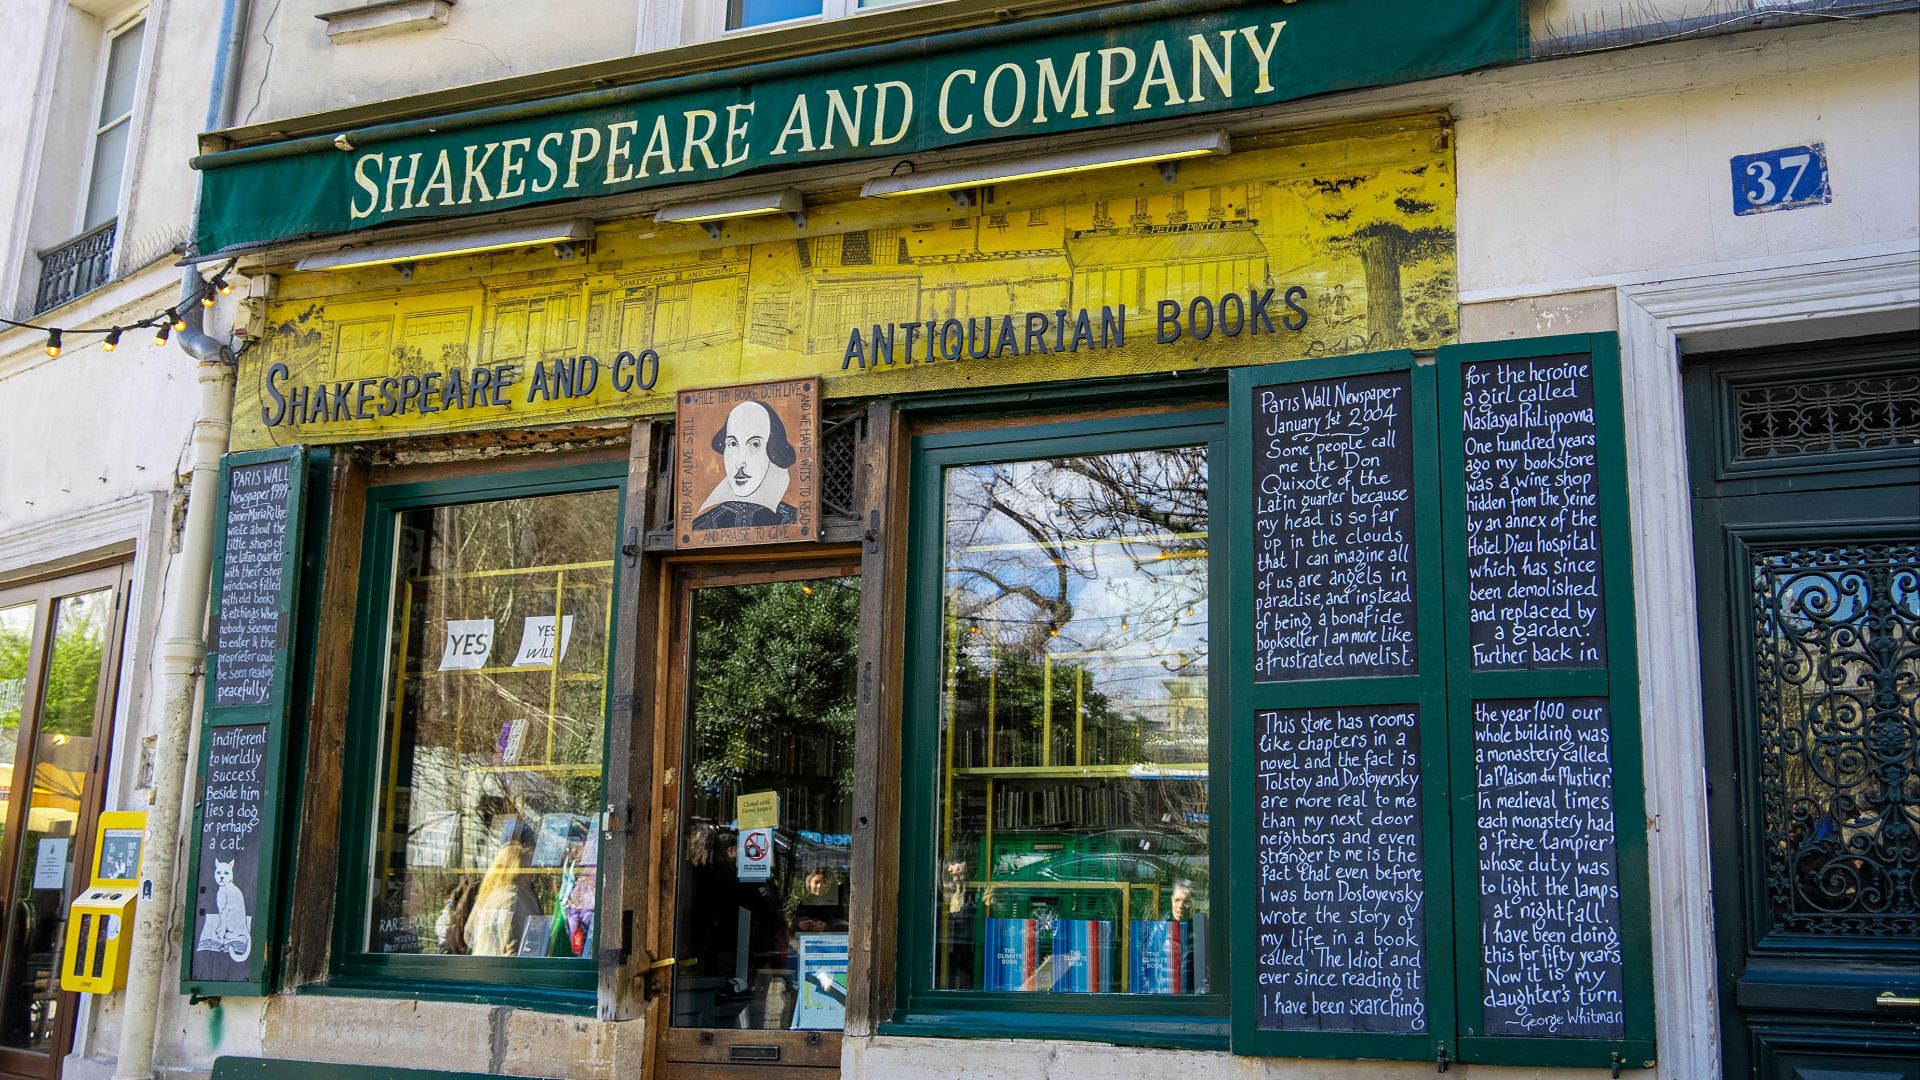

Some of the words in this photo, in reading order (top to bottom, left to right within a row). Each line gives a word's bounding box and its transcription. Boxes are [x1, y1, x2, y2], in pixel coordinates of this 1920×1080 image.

[350, 101, 755, 220] SHAKESPEARE
[770, 80, 913, 155] AND
[938, 21, 1286, 135] COMPANY
[1747, 154, 1809, 205] 37
[618, 276, 668, 288] SHAKESPEARE
[706, 266, 740, 276] COMPANY
[842, 305, 1125, 369] ANTIQUARIAN
[1157, 286, 1308, 344] BOOKS
[1465, 365, 1489, 388] for
[1498, 365, 1525, 383] the
[1530, 363, 1589, 383] heroine
[261, 363, 514, 426] SHAKESPEARE
[527, 355, 598, 402] AND
[612, 349, 659, 393] CO
[692, 392, 713, 405] WHILE
[718, 391, 731, 402] THY
[735, 388, 757, 400] BOOKE
[761, 386, 781, 398] DOTH
[784, 382, 801, 397] LIVE
[1302, 386, 1331, 410] Wall
[1335, 382, 1400, 410] Newspaper
[1464, 391, 1473, 405] a
[1480, 390, 1514, 412] girl
[1519, 380, 1578, 402] called
[801, 394, 810, 411] AND
[683, 417, 694, 443] STILL
[801, 413, 811, 426] WE
[1266, 414, 1321, 436] January
[1325, 413, 1341, 429] 1st
[1349, 404, 1397, 426] 2004
[1463, 406, 1518, 435] Nastasya
[800, 428, 812, 452] HAVE
[1266, 440, 1310, 458] Some
[1316, 436, 1366, 462] people
[1372, 430, 1396, 448] call
[1465, 439, 1493, 455] One
[1498, 435, 1555, 452] hundred
[1559, 434, 1595, 454] years
[682, 449, 693, 474] ALIVE
[801, 458, 812, 481] WITS
[1280, 462, 1298, 474] me
[1310, 456, 1338, 472] the
[1345, 452, 1380, 470] Don
[233, 470, 261, 487] PARIS
[264, 467, 289, 484] WALL
[682, 480, 692, 496] ART
[1262, 474, 1332, 496] Quixote
[1338, 470, 1352, 490] of
[1361, 472, 1390, 486] the
[230, 489, 269, 507] Newspaper
[270, 484, 288, 501] 1999
[801, 486, 810, 496] TO
[1258, 496, 1296, 514] Latin
[1302, 492, 1345, 514] quarter
[1352, 486, 1408, 504] because
[248, 509, 266, 522] Maria
[266, 505, 287, 520] Rilke
[682, 502, 692, 520] THOU
[801, 501, 810, 525] READ
[227, 523, 248, 536] wrote
[250, 521, 270, 535] about
[273, 520, 286, 533] the
[703, 531, 719, 543] AND
[720, 529, 750, 541] PRAISE
[755, 528, 765, 539] TO
[769, 526, 789, 539] GIVE
[225, 565, 239, 578] with
[241, 563, 262, 576] their
[263, 563, 282, 580] shop
[1470, 557, 1517, 578] which
[1523, 557, 1548, 575] has
[1554, 559, 1596, 574] since
[1470, 582, 1501, 600] been
[1508, 577, 1598, 598] demolished
[451, 634, 488, 656] YES
[542, 638, 546, 647] I
[1256, 658, 1263, 671] a
[1266, 648, 1344, 675] frustrated
[1350, 644, 1414, 666] novelist.
[1260, 712, 1295, 734] This
[1301, 713, 1333, 733] store
[1338, 712, 1363, 729] has
[1370, 712, 1415, 728] rooms
[1475, 704, 1498, 722] the
[1501, 706, 1532, 729] year
[1534, 703, 1565, 721] 1600
[1572, 708, 1602, 720] our
[213, 727, 266, 748] indifferent
[1260, 735, 1293, 752] like
[1298, 732, 1366, 755] chapters
[1374, 732, 1386, 746] in
[1396, 733, 1406, 746] a
[209, 750, 220, 766] to
[221, 749, 262, 769] worldly
[1476, 749, 1484, 763] a
[1487, 747, 1559, 770] monastery
[1563, 744, 1609, 763] called
[213, 769, 259, 783] success.
[206, 786, 238, 801] Beside
[241, 786, 259, 800] him
[206, 803, 224, 818] lies
[227, 806, 234, 817] a
[237, 803, 260, 826] dog
[1262, 813, 1295, 827] than
[1305, 815, 1324, 831] my
[1331, 810, 1364, 826] next
[1372, 808, 1413, 825] door
[204, 822, 214, 832] or
[217, 822, 252, 835] perhaps
[1261, 831, 1335, 851] neighbors
[1343, 829, 1371, 844] and
[1379, 833, 1415, 845] even
[209, 837, 216, 849] a
[220, 835, 245, 850] cat.
[1479, 836, 1487, 850] a
[1261, 910, 1306, 925] wrote
[1315, 908, 1341, 923] the
[1349, 906, 1390, 929] story
[1398, 907, 1415, 928] of
[1486, 967, 1522, 986] Now
[1528, 967, 1542, 982] it
[1549, 965, 1564, 980] is
[1575, 970, 1605, 991] my
[1484, 983, 1570, 1015] daughter's
[1579, 987, 1622, 1004] turn.
[1567, 1006, 1623, 1024] Whitman
